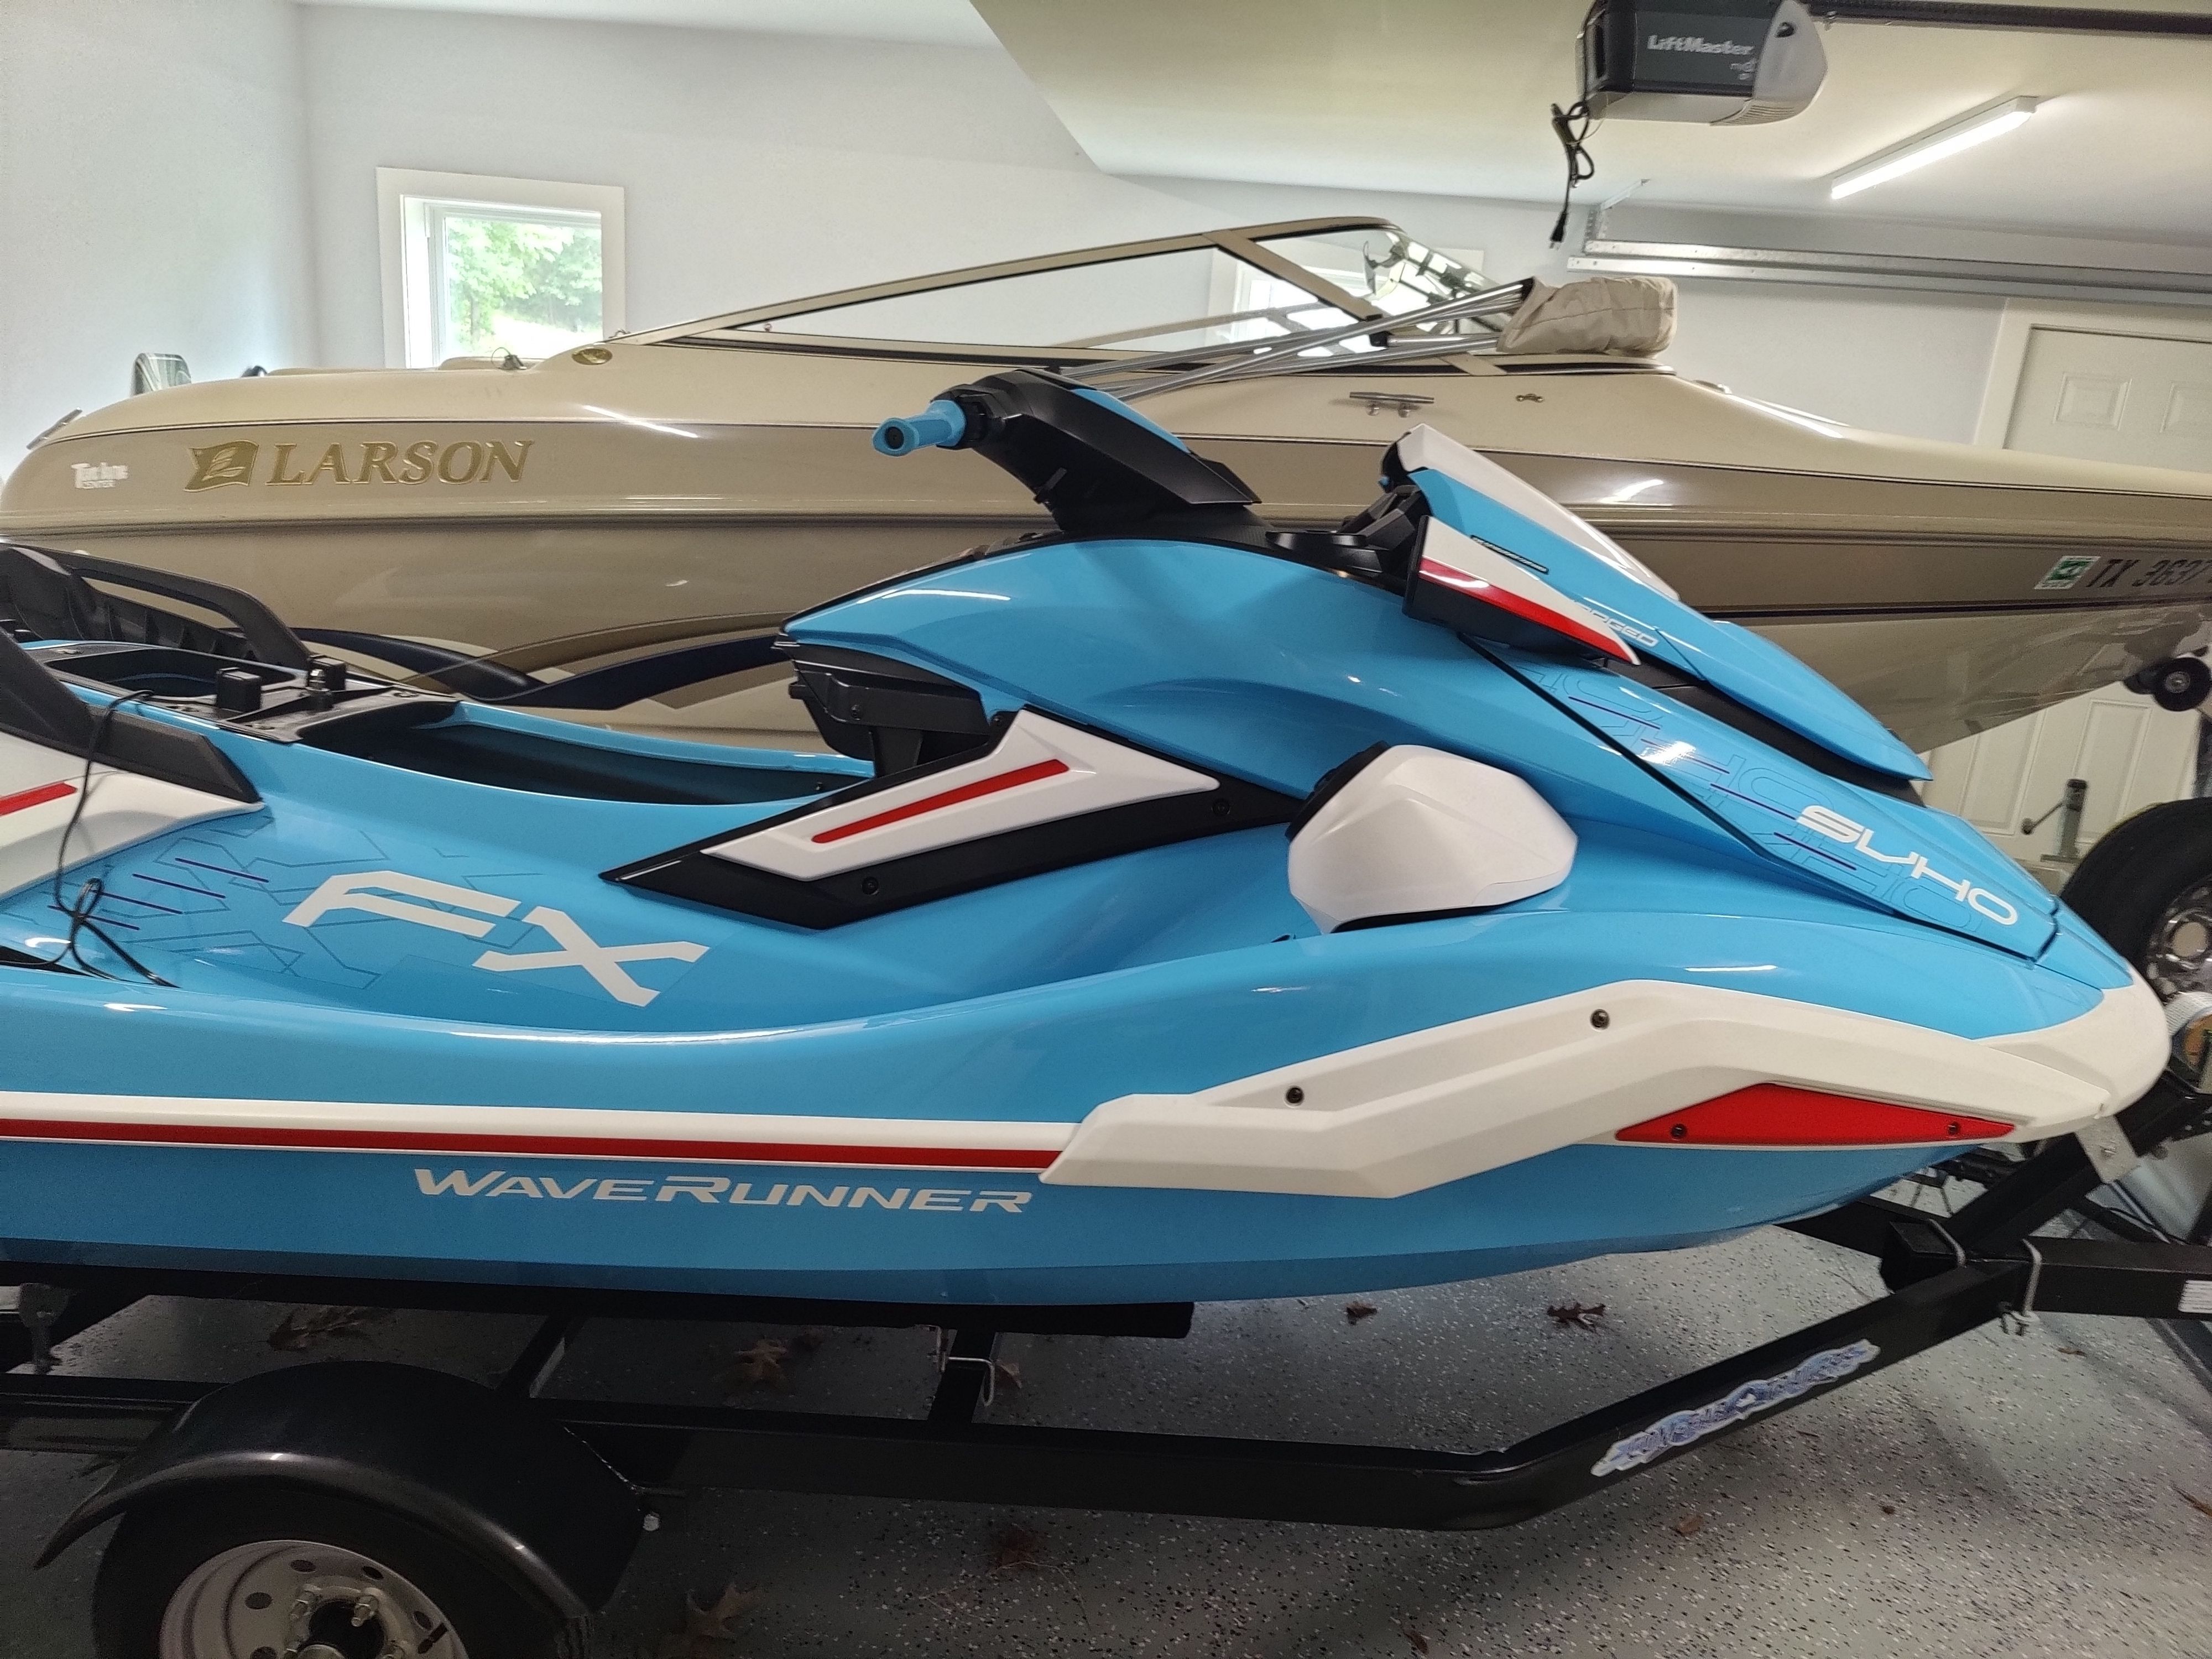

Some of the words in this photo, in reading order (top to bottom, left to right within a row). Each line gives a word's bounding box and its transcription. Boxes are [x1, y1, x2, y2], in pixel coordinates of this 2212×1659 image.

[1647, 35, 1755, 55] LiftMaster
[265, 440, 533, 486] LARSON
[2085, 559, 2140, 587] TX
[283, 870, 710, 1007] FX
[414, 1168, 1032, 1213] WAVERUNNER
